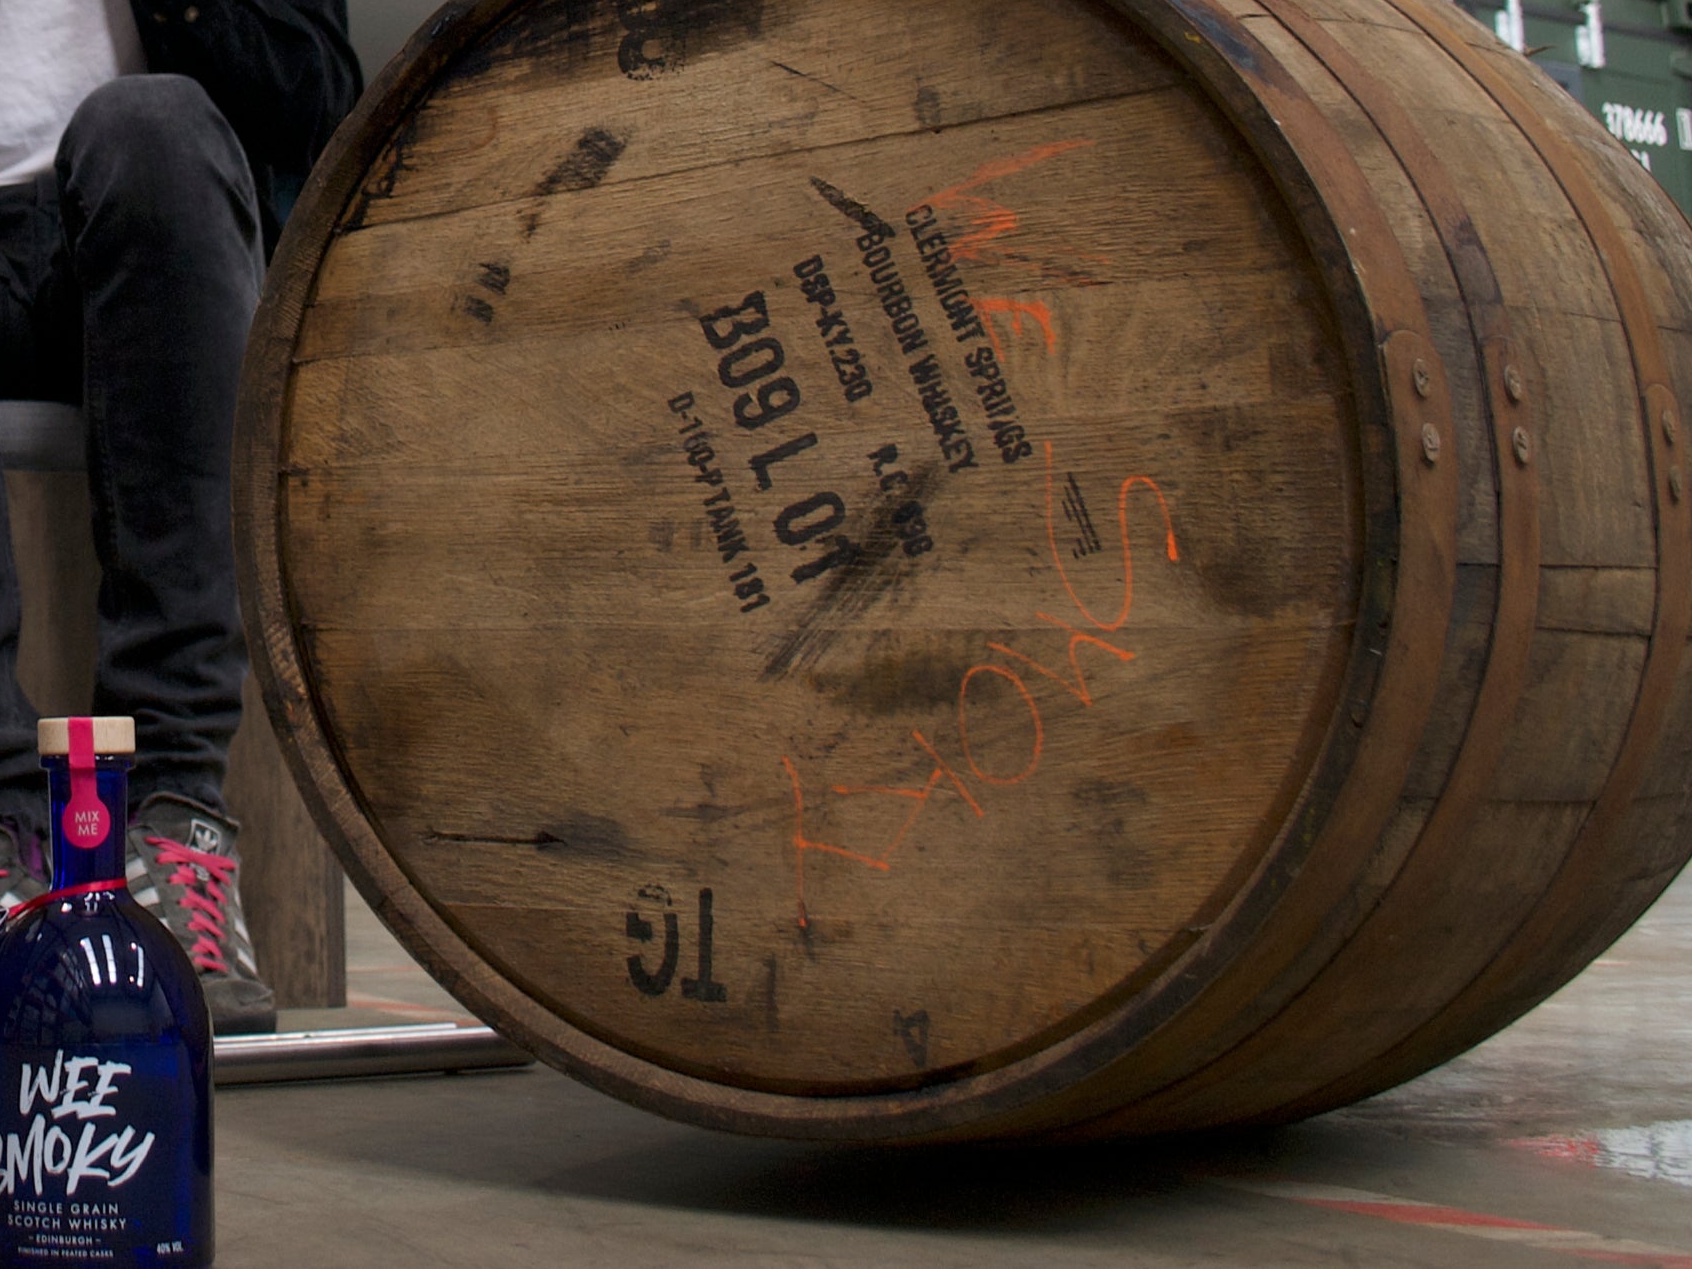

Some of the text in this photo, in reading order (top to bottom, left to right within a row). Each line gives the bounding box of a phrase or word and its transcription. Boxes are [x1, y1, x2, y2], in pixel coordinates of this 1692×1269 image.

[700, 291, 801, 430] B09
[856, 232, 979, 475] BOURBON WHISKEY
[905, 203, 1032, 464] CLERMONT SPRINGS
[748, 432, 818, 491] L
[702, 487, 749, 562] TANK
[75, 811, 99, 822] MIX
[78, 823, 98, 835] ME
[19, 1049, 133, 1120] WEE
[8, 1214, 127, 1230] SCOTCH WHISKY
[14, 1200, 119, 1215] SINGLE GRAIN
[36, 1234, 92, 1245] EDINBURGH
